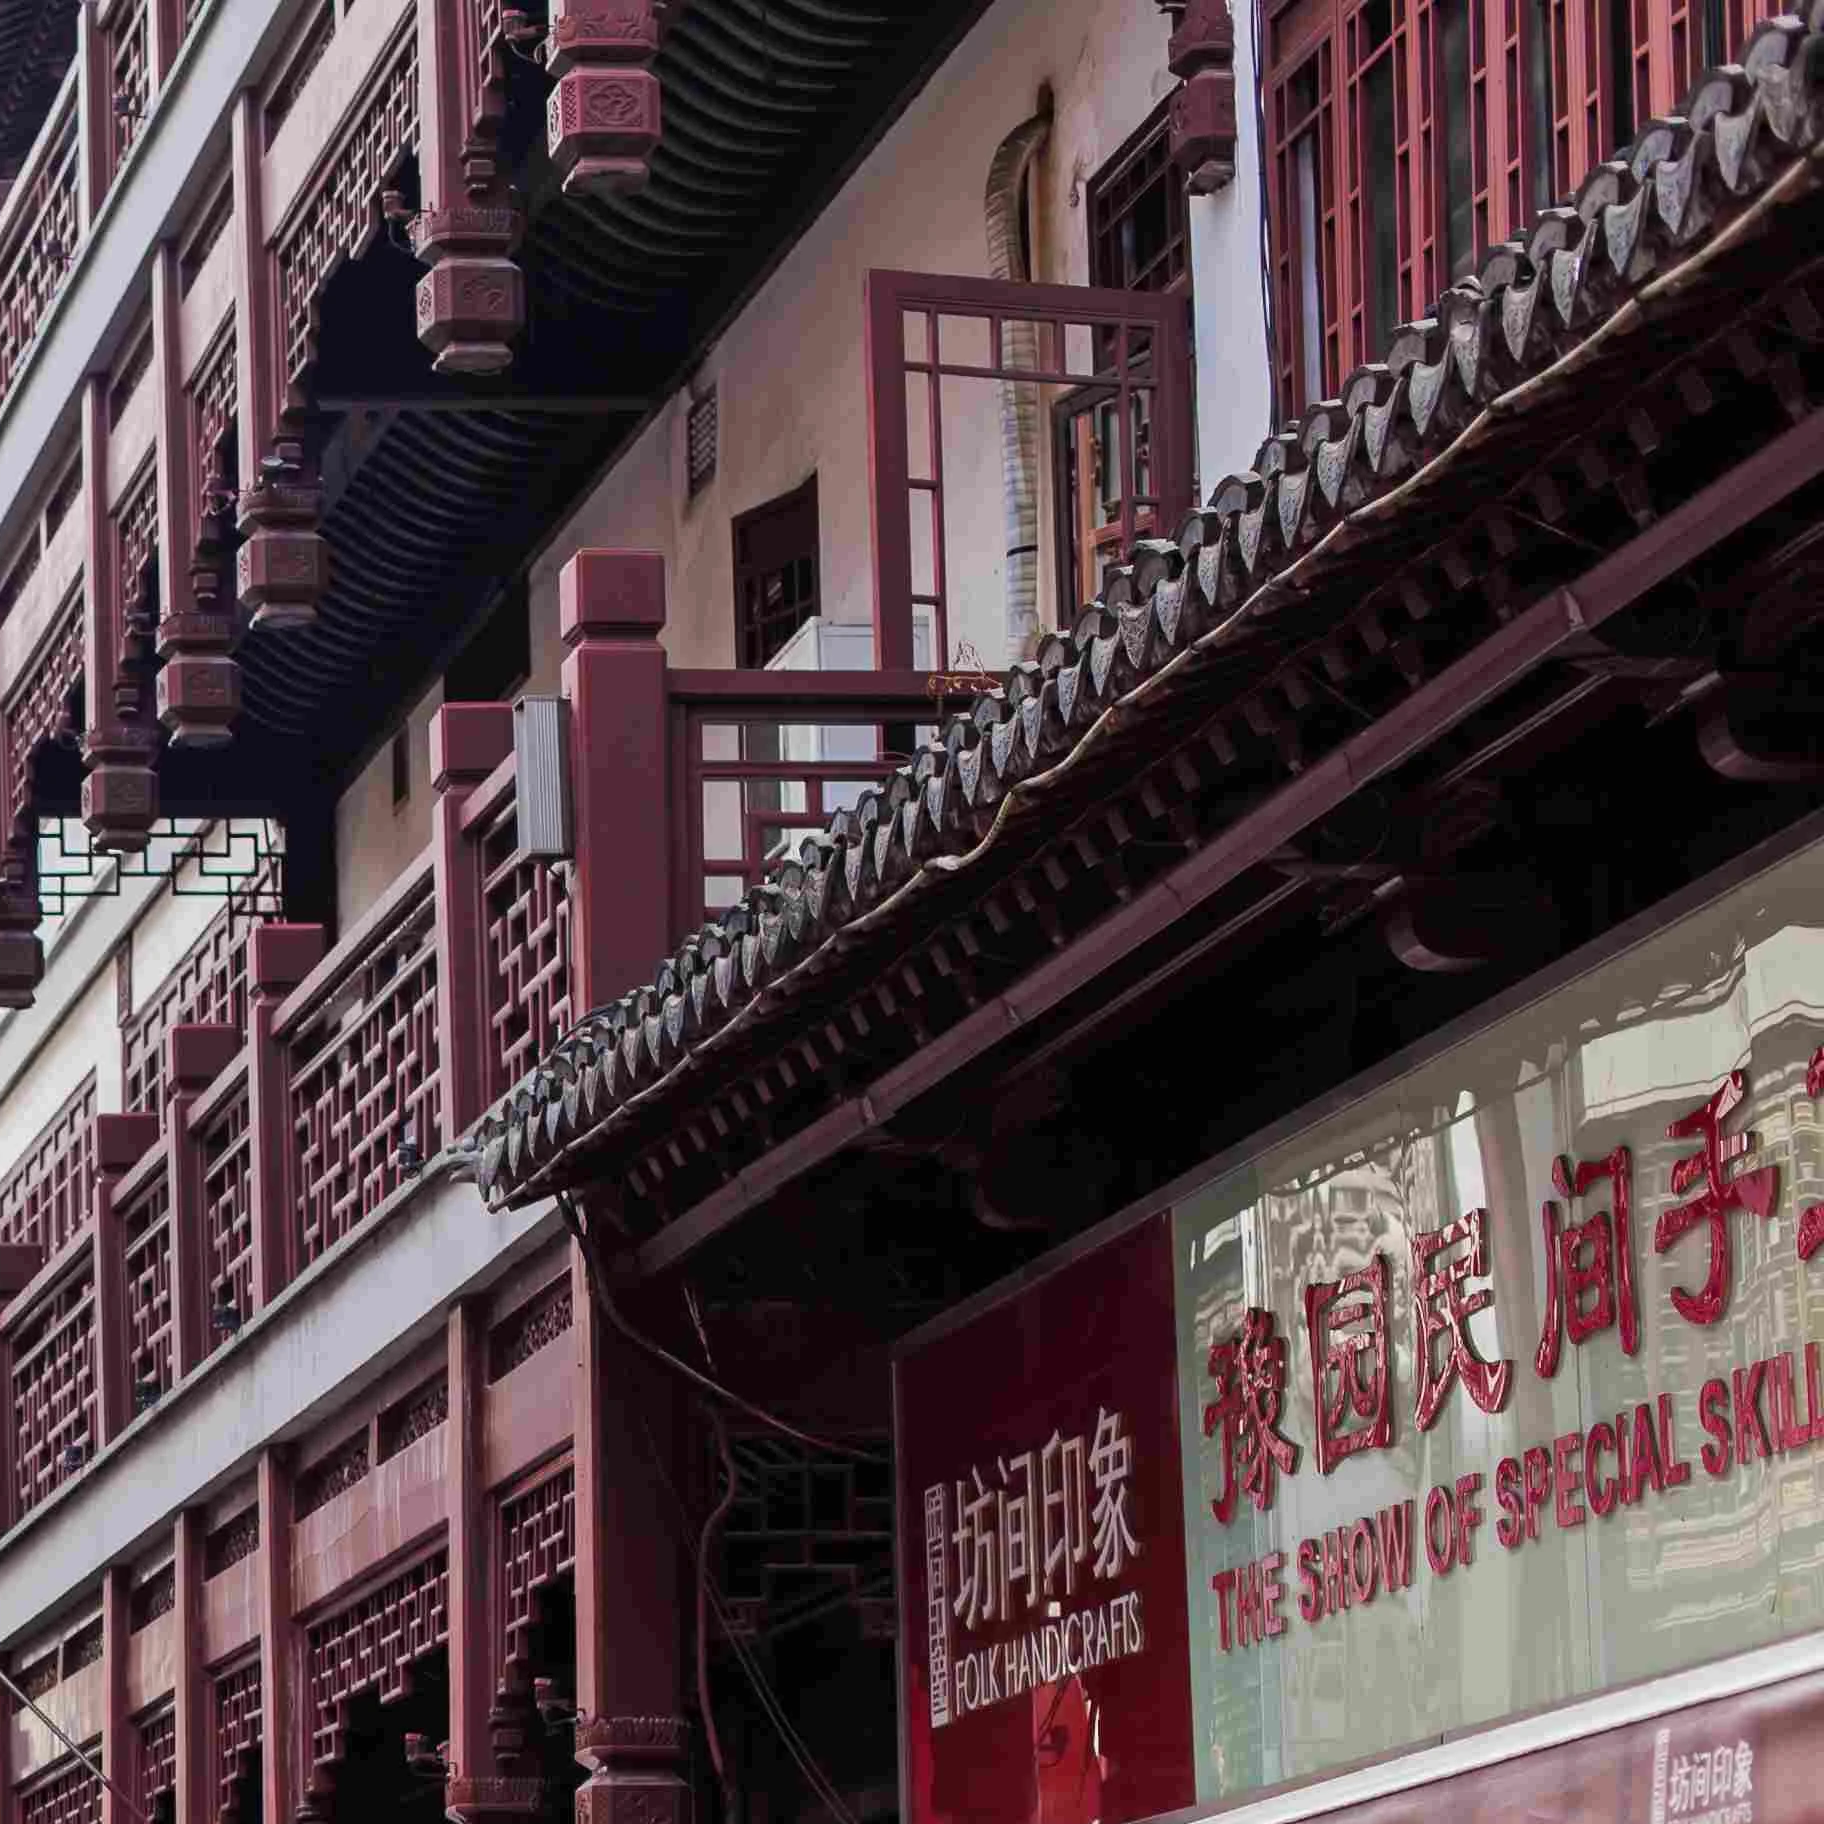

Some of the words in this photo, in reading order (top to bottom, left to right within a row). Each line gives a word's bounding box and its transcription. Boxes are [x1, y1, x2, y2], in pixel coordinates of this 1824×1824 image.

[1203, 1045, 1824, 1525] 豫园民间手
[951, 1405, 1143, 1632] 坊间印象
[1211, 1551, 1288, 1657] THE
[1296, 1499, 1414, 1625] SHOW
[1424, 1471, 1483, 1578] OF
[1494, 1392, 1691, 1550] SPECIAL
[954, 1643, 1001, 1717] FOLK
[1004, 1591, 1144, 1697] HANDICRAFTS
[1669, 1739, 1753, 1813] 坊间印象
